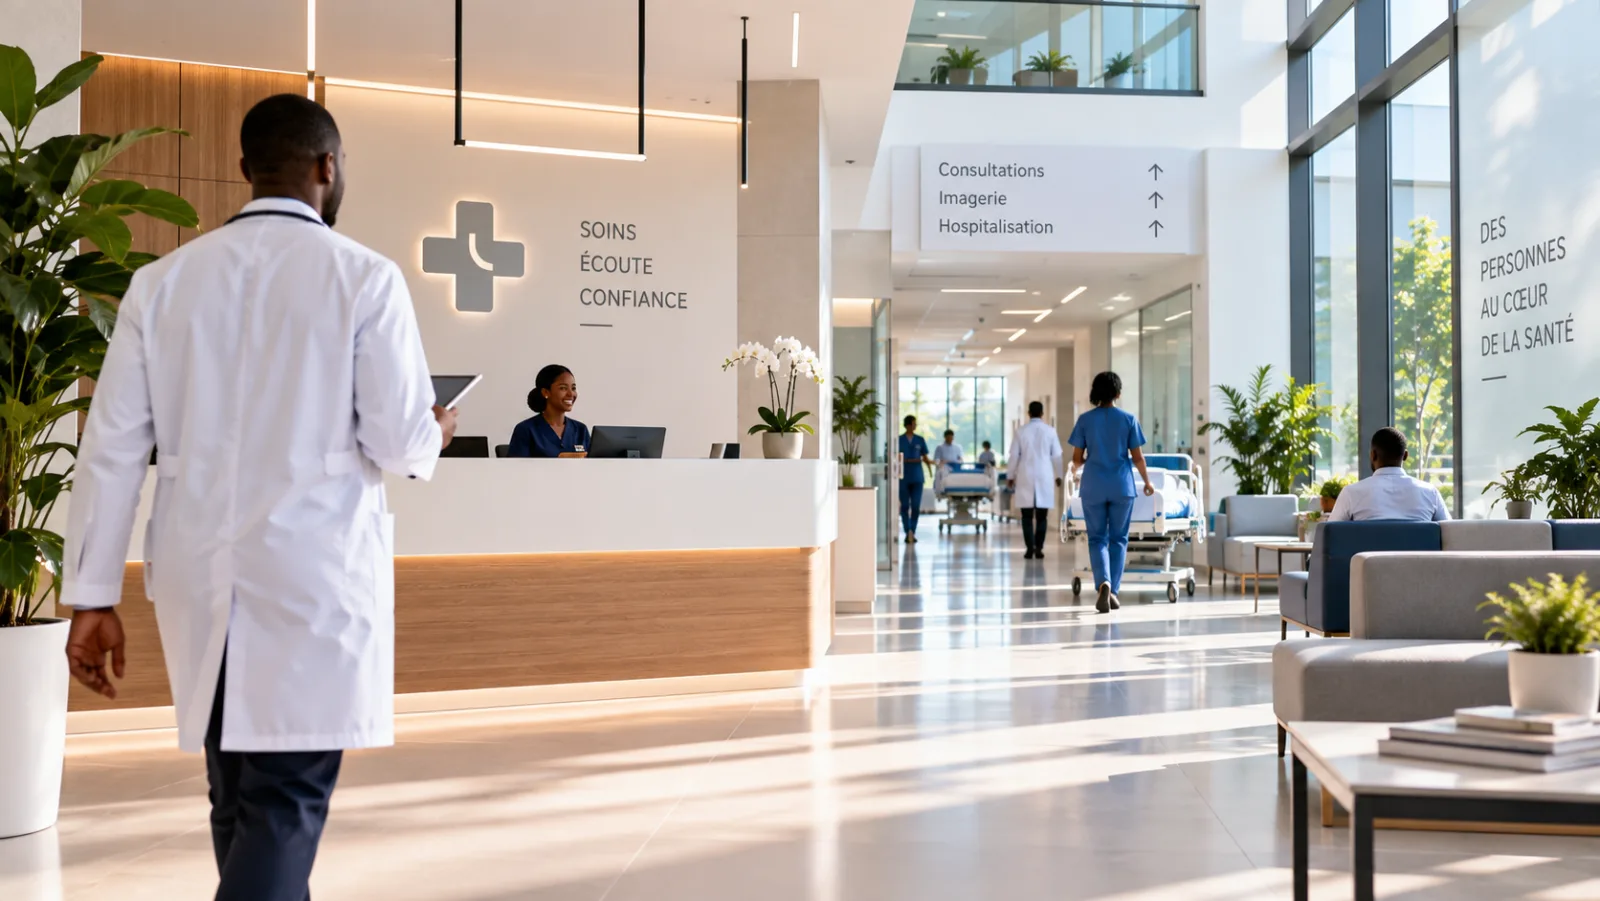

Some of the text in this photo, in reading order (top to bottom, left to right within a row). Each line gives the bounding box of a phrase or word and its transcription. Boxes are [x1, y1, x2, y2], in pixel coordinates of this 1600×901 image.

[938, 161, 1045, 178] Consultations
[939, 190, 1008, 209] Imagerie
[580, 220, 637, 241] SOINS
[939, 218, 1054, 237] Hospitalisation
[1480, 215, 1507, 244] DES
[580, 250, 653, 275] ÉCOUTE
[1480, 235, 1567, 282] PERSONNES
[580, 287, 688, 310] CONFIANCE
[1480, 282, 1548, 319] AU CŒUR
[1481, 312, 1575, 357] DE LA SANTÉ
